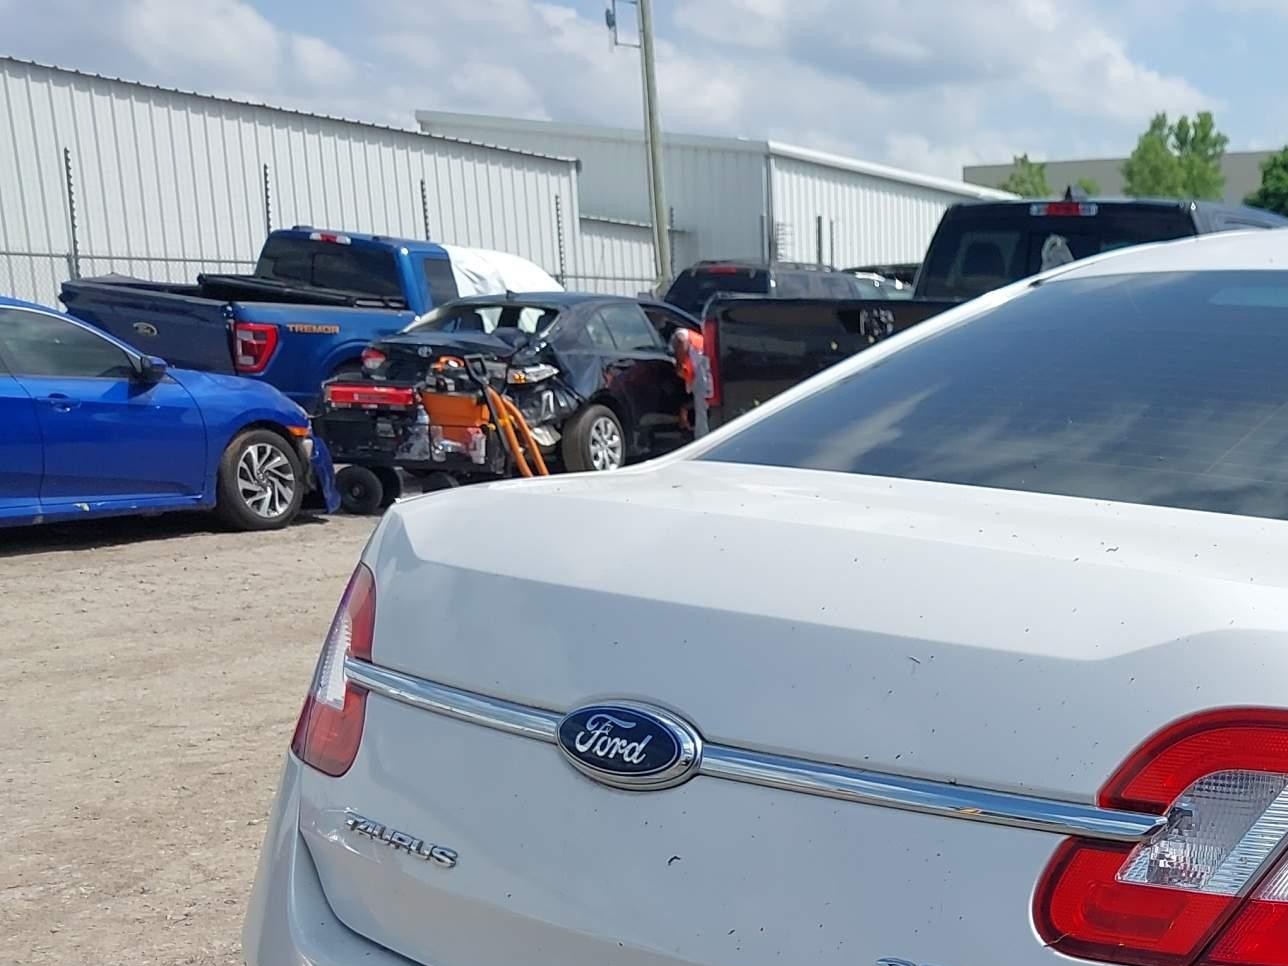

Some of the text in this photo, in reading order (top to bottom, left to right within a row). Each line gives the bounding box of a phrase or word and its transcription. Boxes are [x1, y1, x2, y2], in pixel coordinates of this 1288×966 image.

[287, 323, 340, 334] TREMOR
[575, 713, 653, 764] Ford
[344, 806, 459, 868] TAURUS
